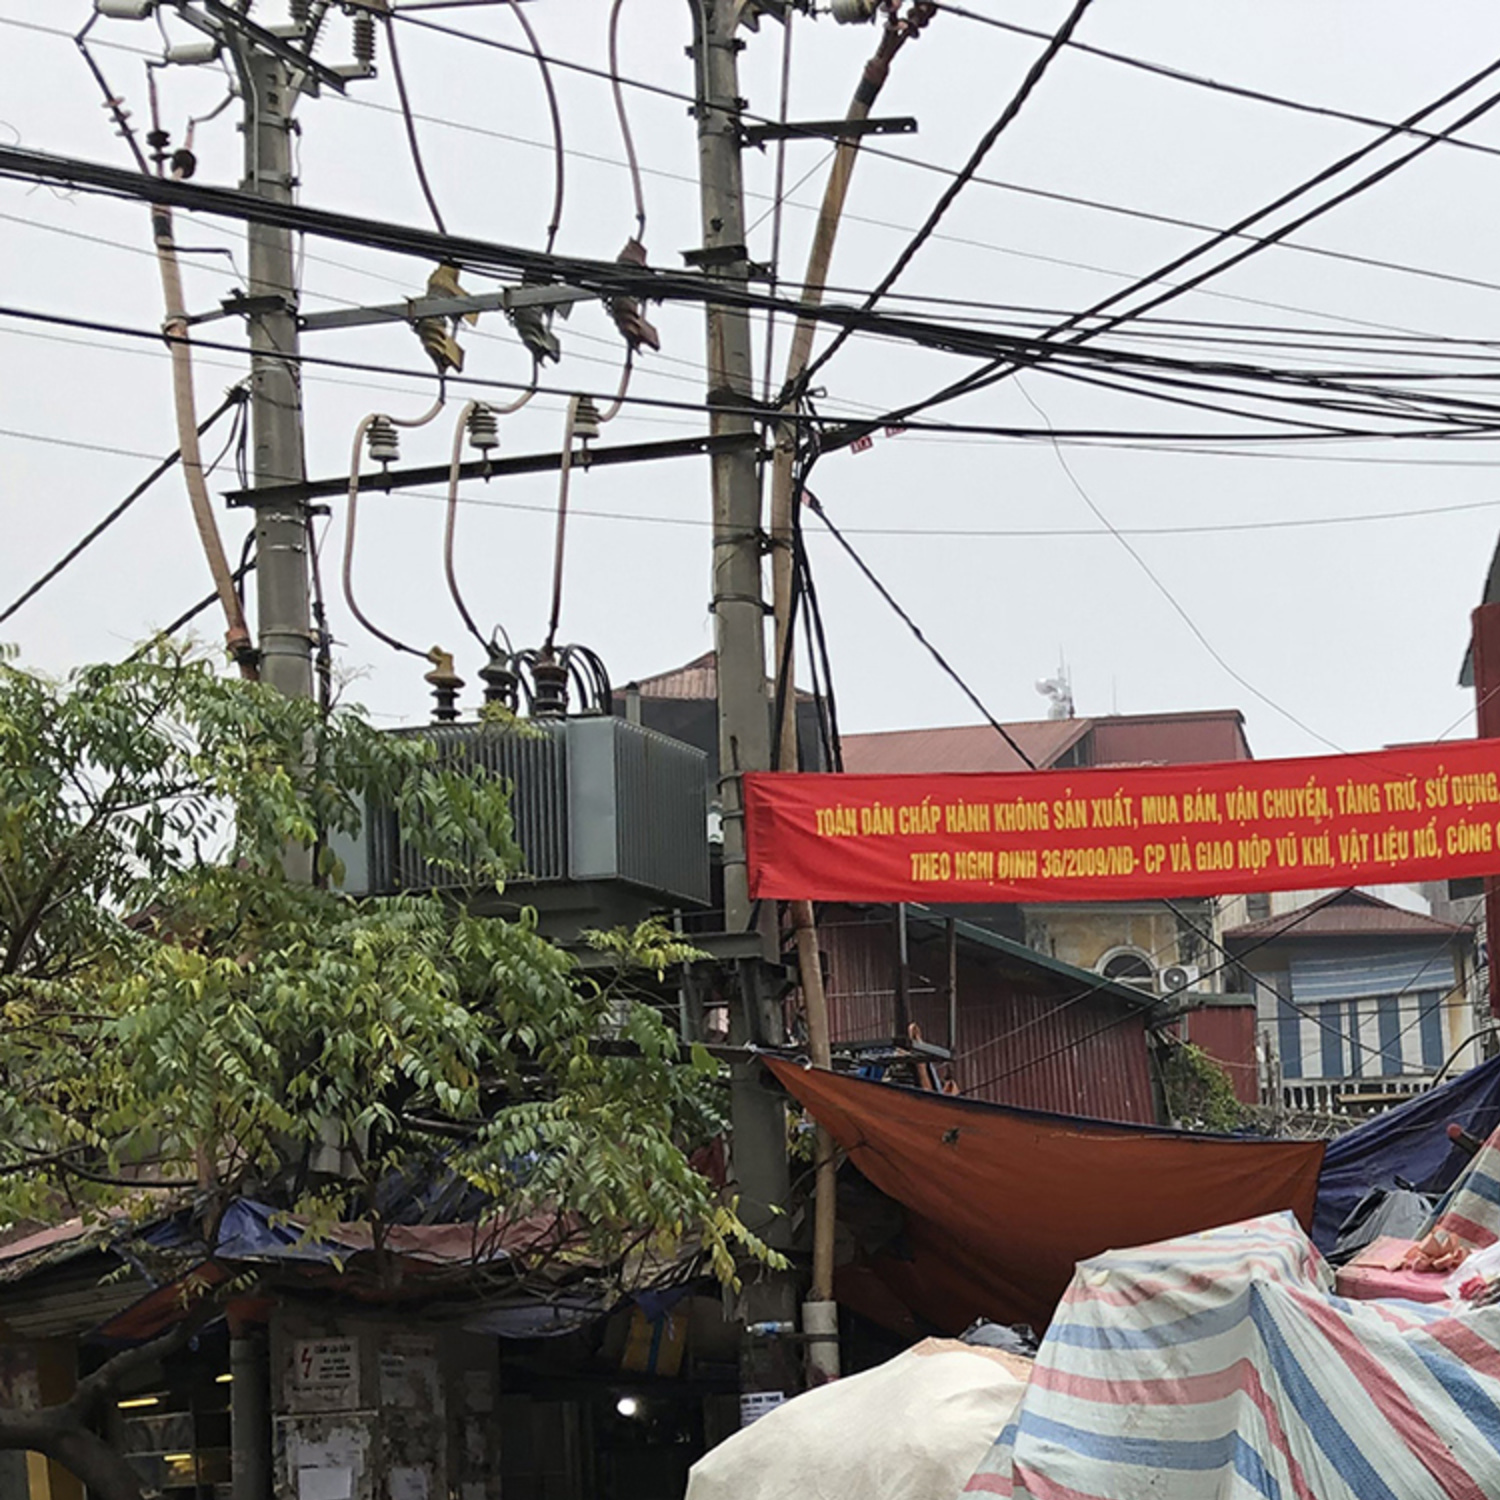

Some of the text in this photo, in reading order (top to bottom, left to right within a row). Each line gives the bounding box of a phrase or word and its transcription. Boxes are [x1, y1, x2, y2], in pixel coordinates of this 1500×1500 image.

[816, 803, 857, 837] TOÀN
[861, 801, 895, 836] DÂN
[899, 795, 941, 835] CHẤP
[946, 797, 990, 834] HÀNH
[994, 796, 1049, 832] KHÔNG
[1053, 786, 1088, 830] SẢN
[1092, 787, 1138, 830] XUẤT,
[1143, 796, 1180, 827] MUA
[1183, 788, 1223, 826] BÁN,
[1226, 783, 1258, 827] VẬN
[1262, 775, 1334, 825] CHUYỂN,
[1336, 779, 1380, 816] TÀNG
[1384, 773, 1421, 813] TRỮ,
[1425, 764, 1449, 808] SỬ
[911, 851, 950, 882] THEO
[954, 850, 995, 887] NGHỊ
[999, 847, 1037, 886] ĐỊNH
[1144, 846, 1166, 874] CP
[1170, 836, 1192, 873] VÀ
[1196, 840, 1234, 871] GIAO
[1238, 831, 1272, 871] NỘP
[1276, 832, 1298, 868] VŨ
[1302, 831, 1335, 869] KHÍ,
[1339, 829, 1370, 868] VẬT
[1374, 828, 1409, 868] LIỆU
[1413, 816, 1442, 859] NỔ,
[1446, 820, 1492, 855] CÔNG
